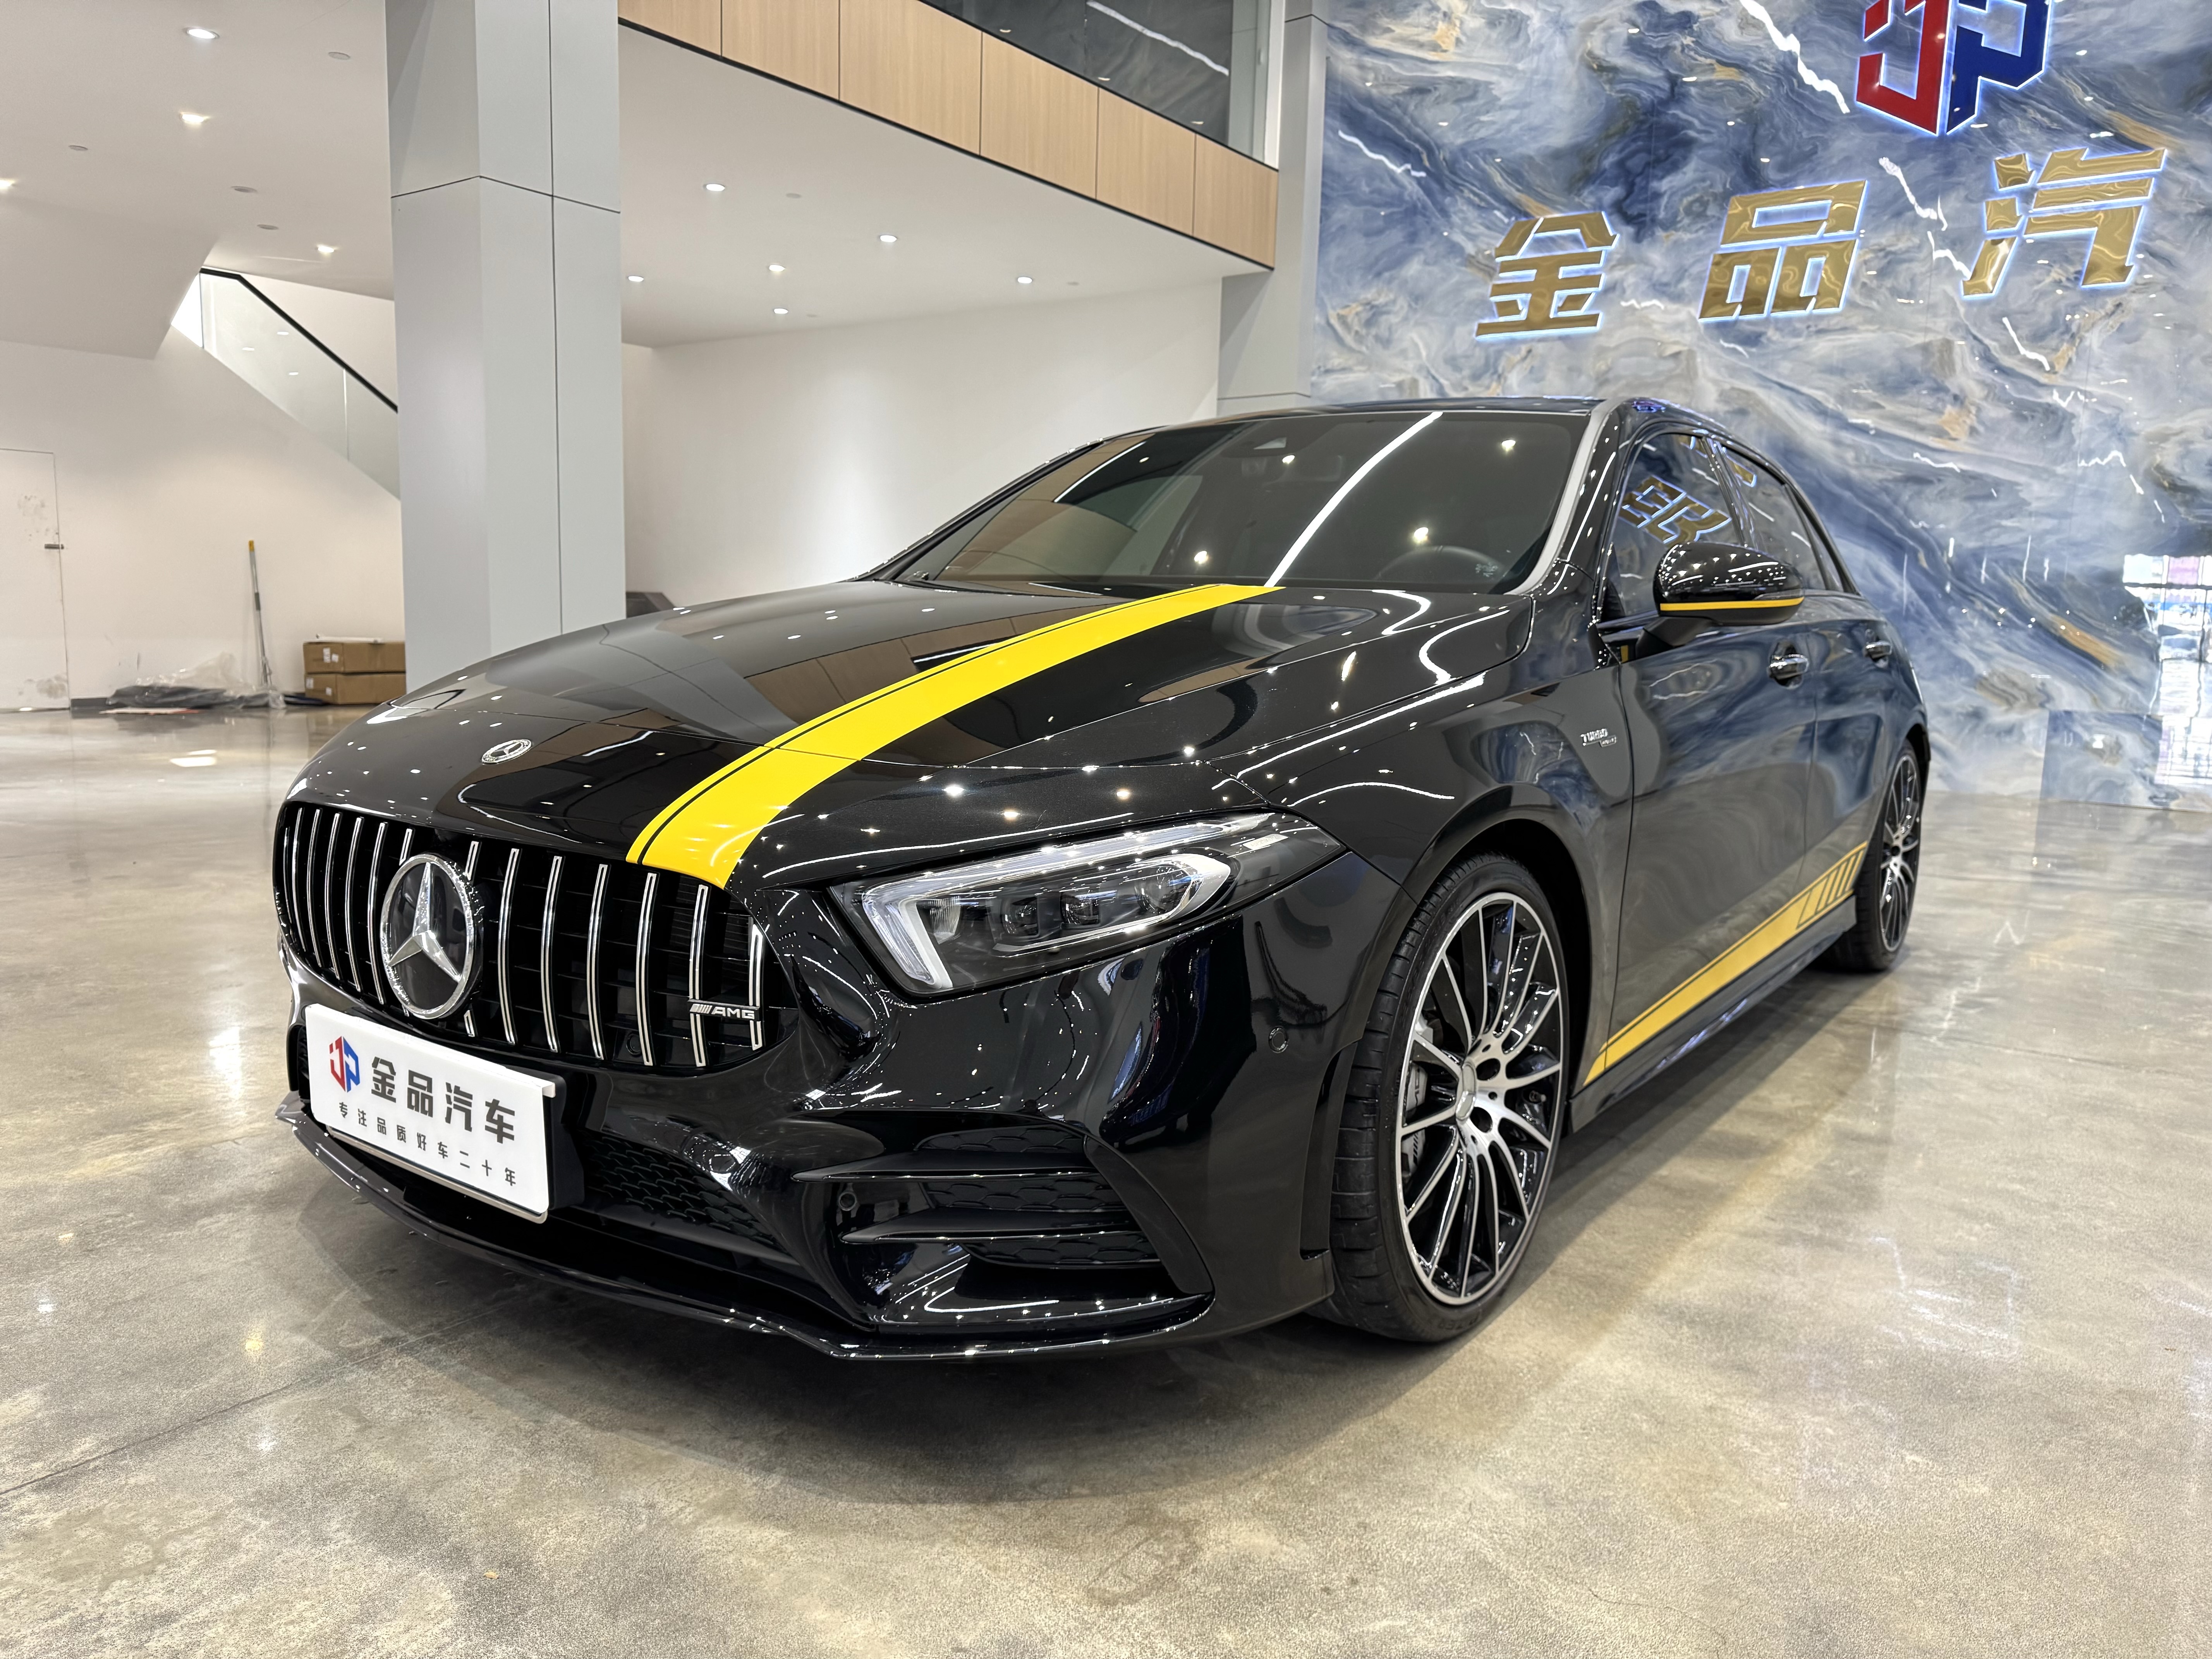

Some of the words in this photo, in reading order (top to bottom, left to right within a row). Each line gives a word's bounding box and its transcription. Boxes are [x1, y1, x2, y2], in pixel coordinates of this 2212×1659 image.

[1475, 148, 2167, 340] 金品汽
[711, 1006, 755, 1020] AMG
[371, 1056, 515, 1144] 金品汽车
[338, 1101, 517, 1187] 专注品质好车二十年
